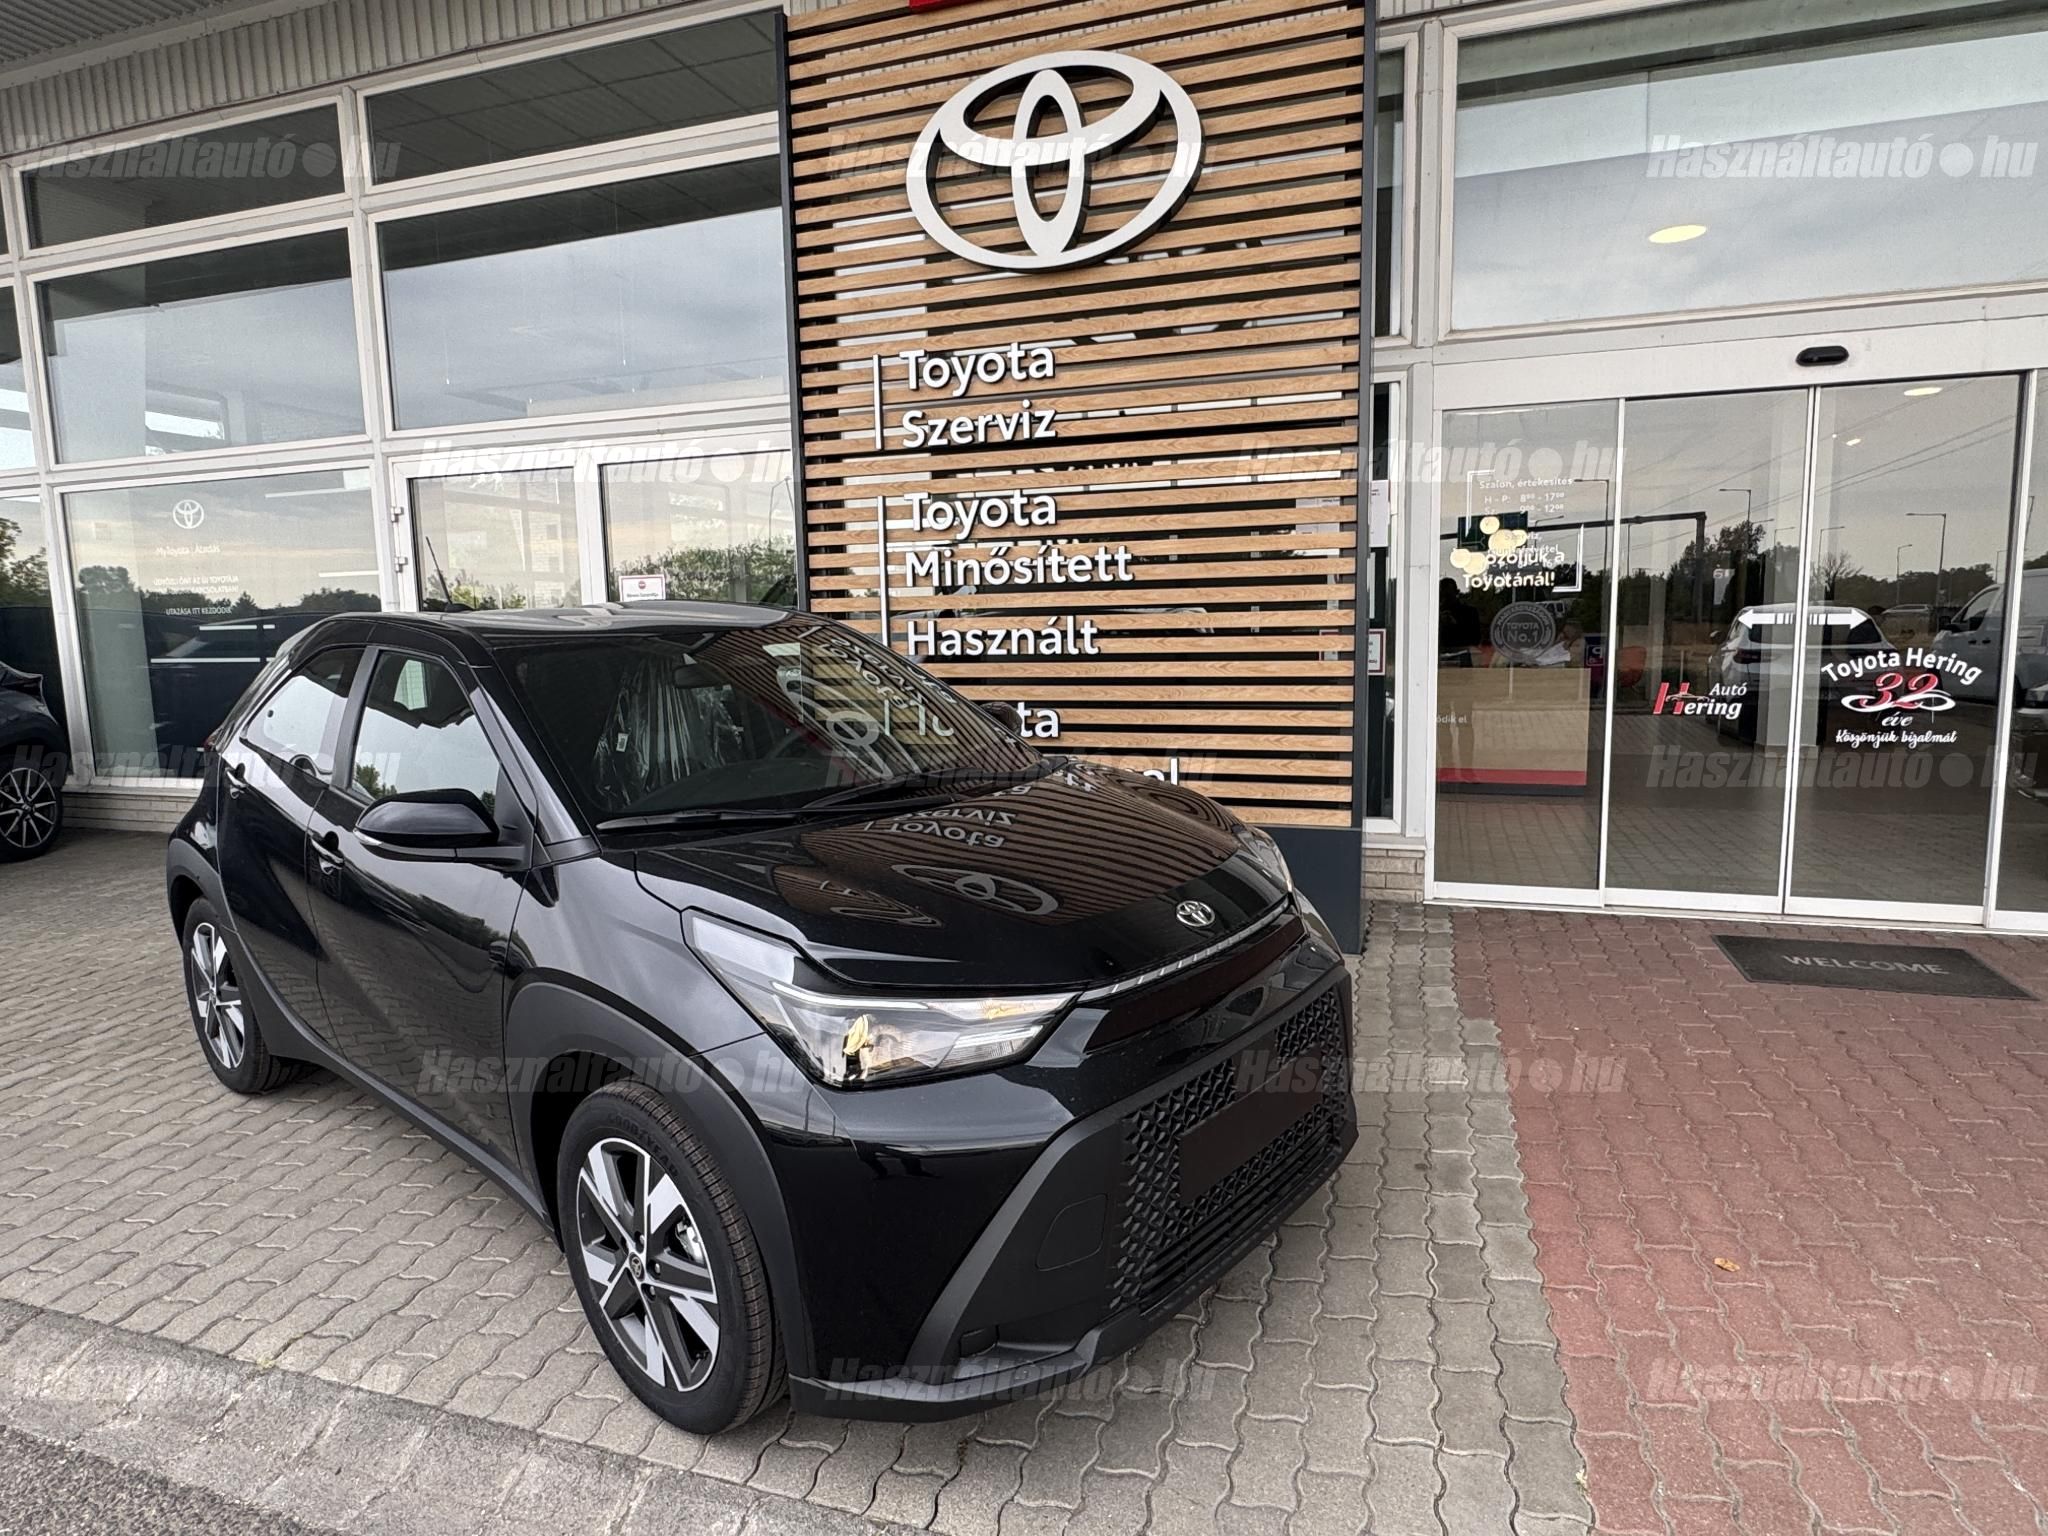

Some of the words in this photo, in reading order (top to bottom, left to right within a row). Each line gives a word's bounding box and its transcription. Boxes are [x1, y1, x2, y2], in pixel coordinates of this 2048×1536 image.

[900, 342, 1056, 398] Toyota
[902, 399, 1057, 449] Szerviz
[904, 489, 1057, 541] Toyota
[905, 545, 1134, 588] Minősített
[1462, 571, 1556, 591] Toyotánál!
[908, 616, 1100, 656] Használt
[1506, 622, 1539, 630] TOYOTA
[1821, 649, 1901, 683] Toyota
[1905, 647, 1984, 686] Hering
[1709, 681, 1748, 697] Autó
[1835, 729, 1900, 749] Köszönjük
[1901, 730, 1957, 749] bizalmát
[1781, 953, 1950, 975] WELCOME
